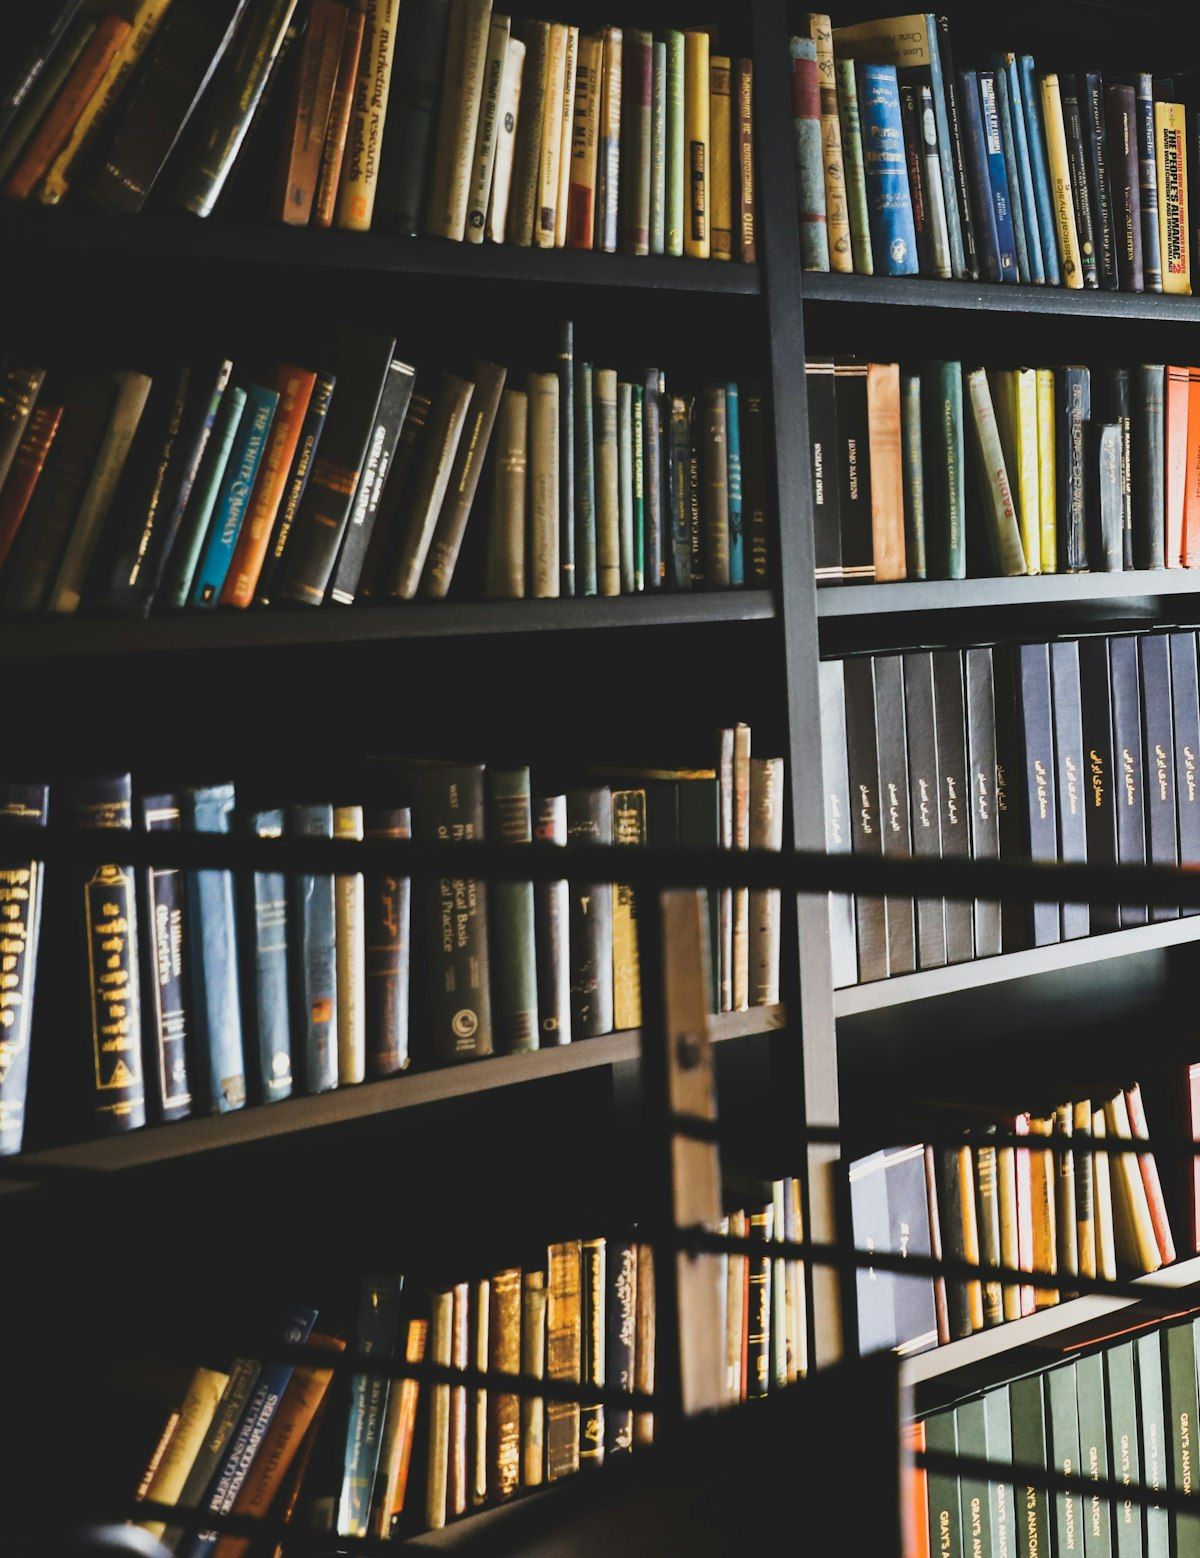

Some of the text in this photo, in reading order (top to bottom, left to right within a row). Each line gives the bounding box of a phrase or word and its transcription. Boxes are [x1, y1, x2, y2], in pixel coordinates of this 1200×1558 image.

[365, 28, 392, 185] marketing research:
[1092, 90, 1102, 133] Microsoft
[349, 83, 368, 182] and methods
[573, 127, 586, 158] МЕЧ
[991, 128, 1002, 155] EXAMPLE
[1096, 136, 1104, 166] Visual
[1169, 130, 1177, 149] THE
[743, 143, 752, 204] ПРОИСХОДИЛО
[1098, 168, 1106, 192] Basic
[1170, 152, 1179, 202] PEOPLE'S
[1056, 178, 1068, 220] physics
[1083, 186, 1093, 241] ORGANIZATION
[1099, 193, 1107, 207] 6.0
[1171, 205, 1180, 259] ALMANAC
[1172, 263, 1181, 274] 2
[253, 405, 271, 431] THE
[944, 400, 953, 444] CALCULUS
[240, 436, 266, 483] WHITE
[635, 402, 643, 498] THE CRYSTAL GARDEN
[848, 439, 858, 499] HOMO SAPIENS
[1071, 384, 1083, 524] ENGINEERING DRAWING
[353, 424, 386, 525] GENERAL RELATIVITY
[690, 458, 698, 487] CAPER
[814, 443, 824, 505] HOMO SAPIENS
[997, 469, 1013, 518] RADIO
[273, 434, 315, 558] GLACIER PROJECT PAPERS
[441, 901, 454, 953] Practice
[456, 913, 468, 947] Basis
[240, 1394, 277, 1468] COMPUTERS
[1150, 1423, 1159, 1459] GRAY'S
[1180, 1413, 1190, 1448] GRAY'S
[1089, 1446, 1099, 1481] GRAY'S
[1121, 1435, 1130, 1471] GRAY'S
[971, 1498, 982, 1536] GRAY'S
[997, 1484, 1007, 1522] GRAY'S
[1065, 1498, 1074, 1549] ANATOMY
[939, 1510, 949, 1548] GRAY'S
